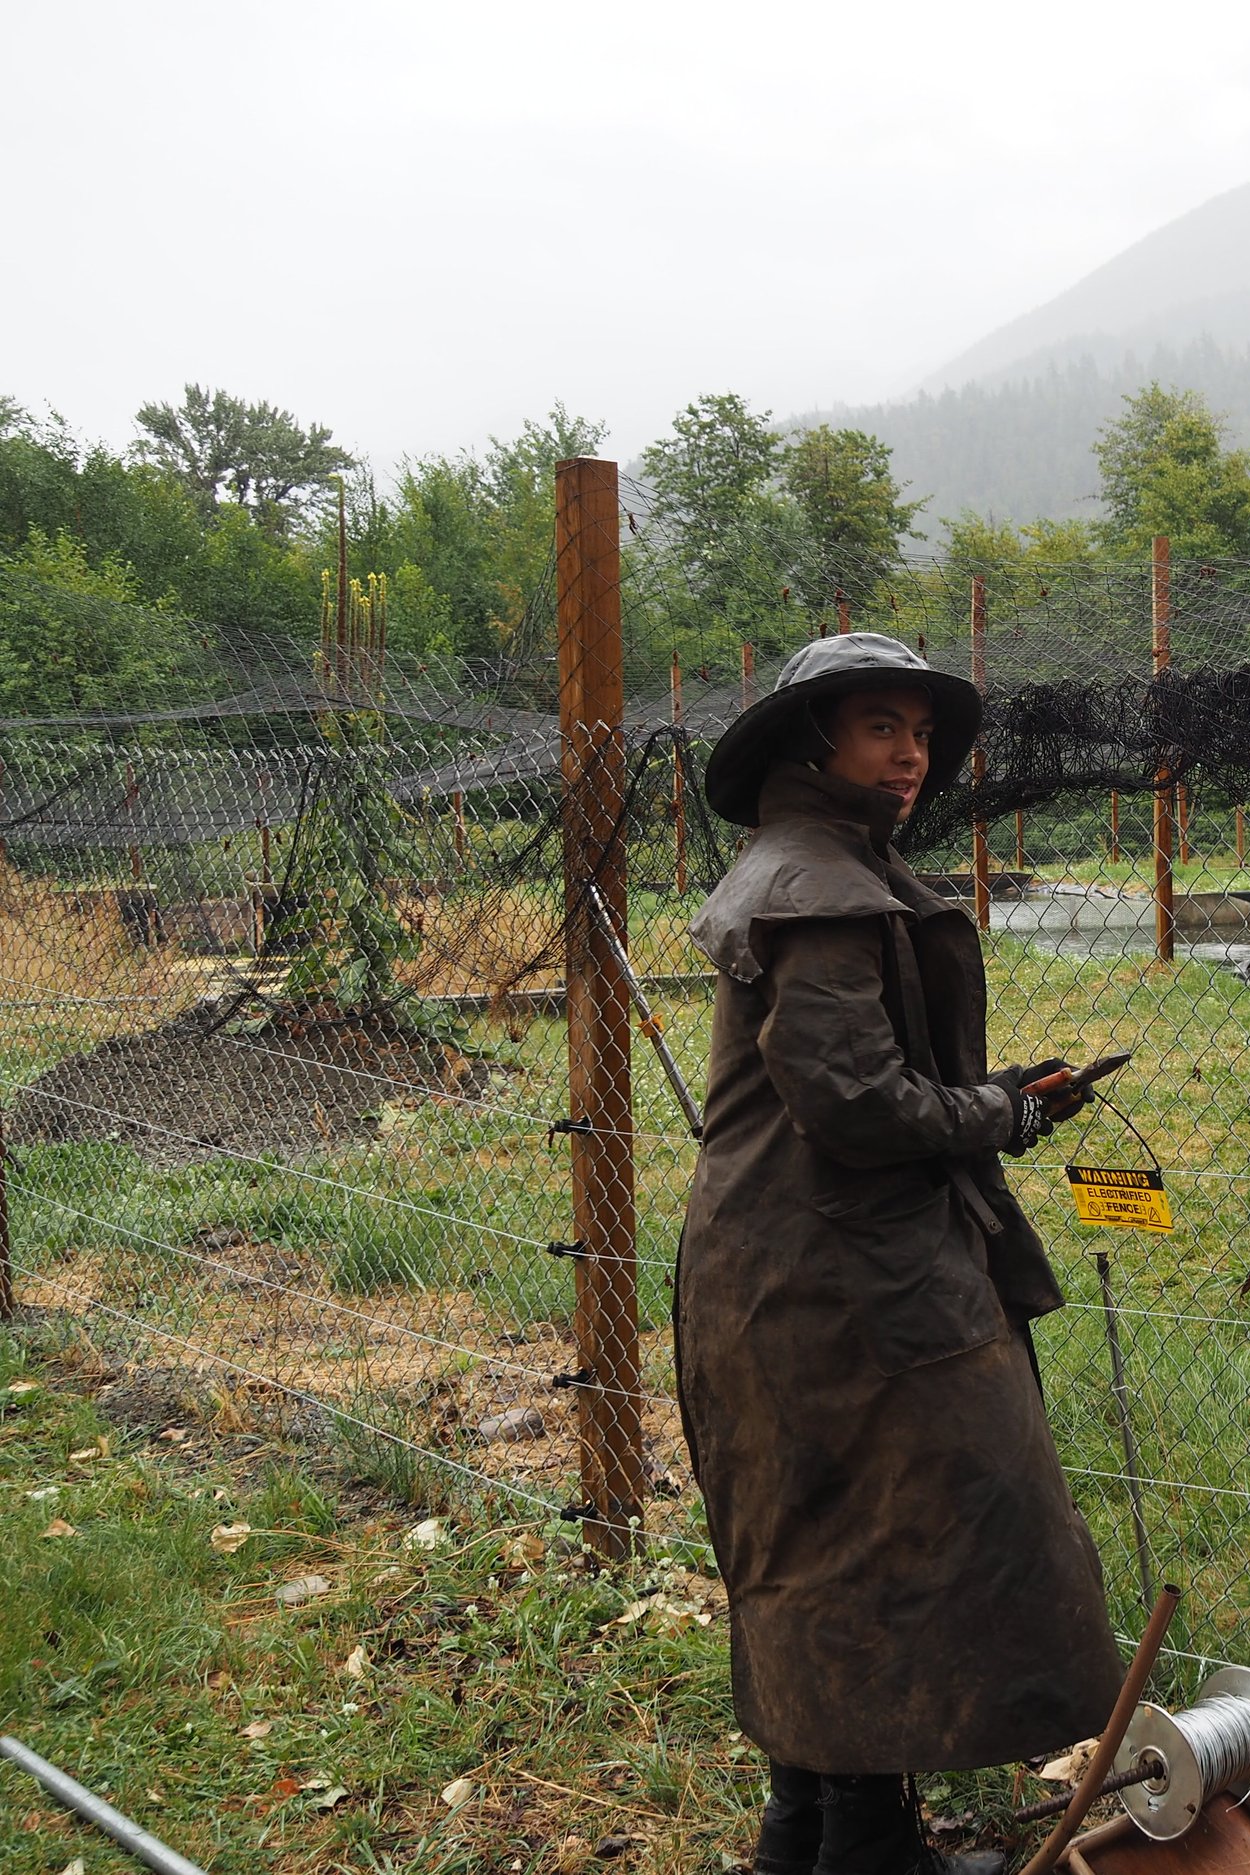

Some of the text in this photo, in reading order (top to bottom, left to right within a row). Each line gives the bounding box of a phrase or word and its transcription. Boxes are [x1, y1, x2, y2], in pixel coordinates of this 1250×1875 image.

[1078, 1169, 1150, 1187] WARNING
[1087, 1188, 1151, 1202] ELECTRIFIED
[1106, 1202, 1140, 1214] FENCE
